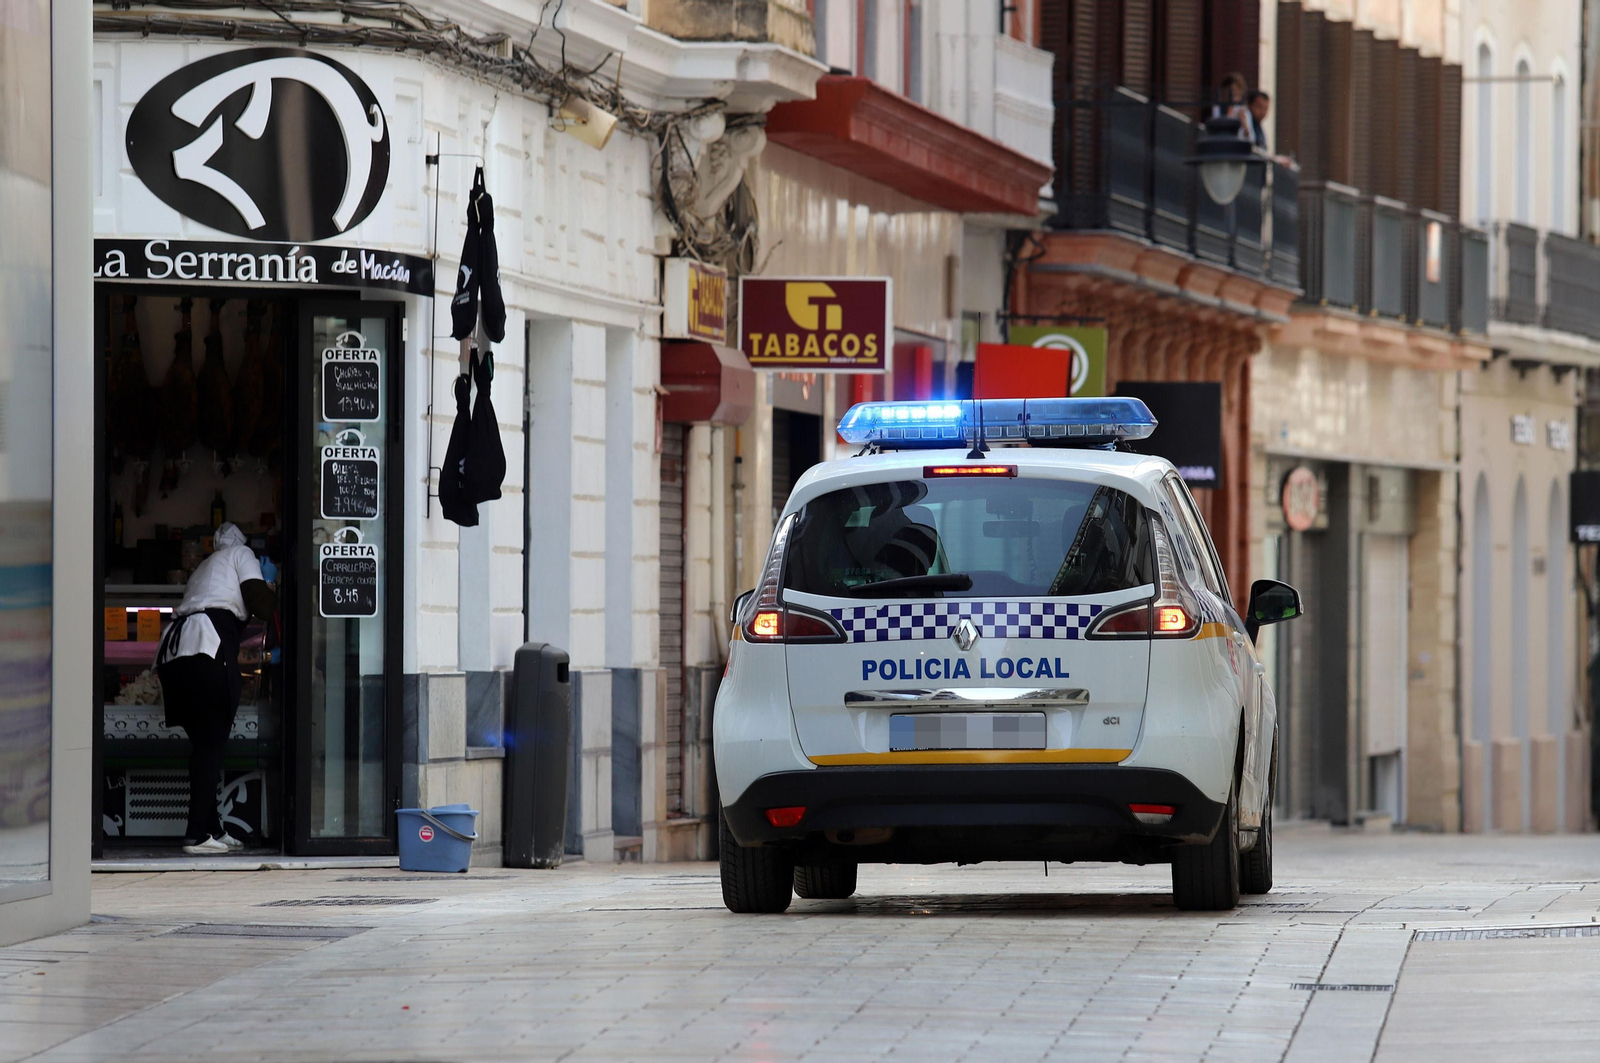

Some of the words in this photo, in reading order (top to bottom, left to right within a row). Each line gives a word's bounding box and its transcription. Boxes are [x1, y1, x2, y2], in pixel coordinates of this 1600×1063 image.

[144, 239, 319, 283] Serranía
[331, 249, 358, 274] de
[749, 333, 878, 357] TABACOS
[325, 350, 377, 360] OFERTA
[324, 448, 376, 458] OFERTA
[323, 546, 375, 556] OFERTA
[862, 659, 971, 681] POLICIA
[980, 658, 1070, 679] LOCAL
